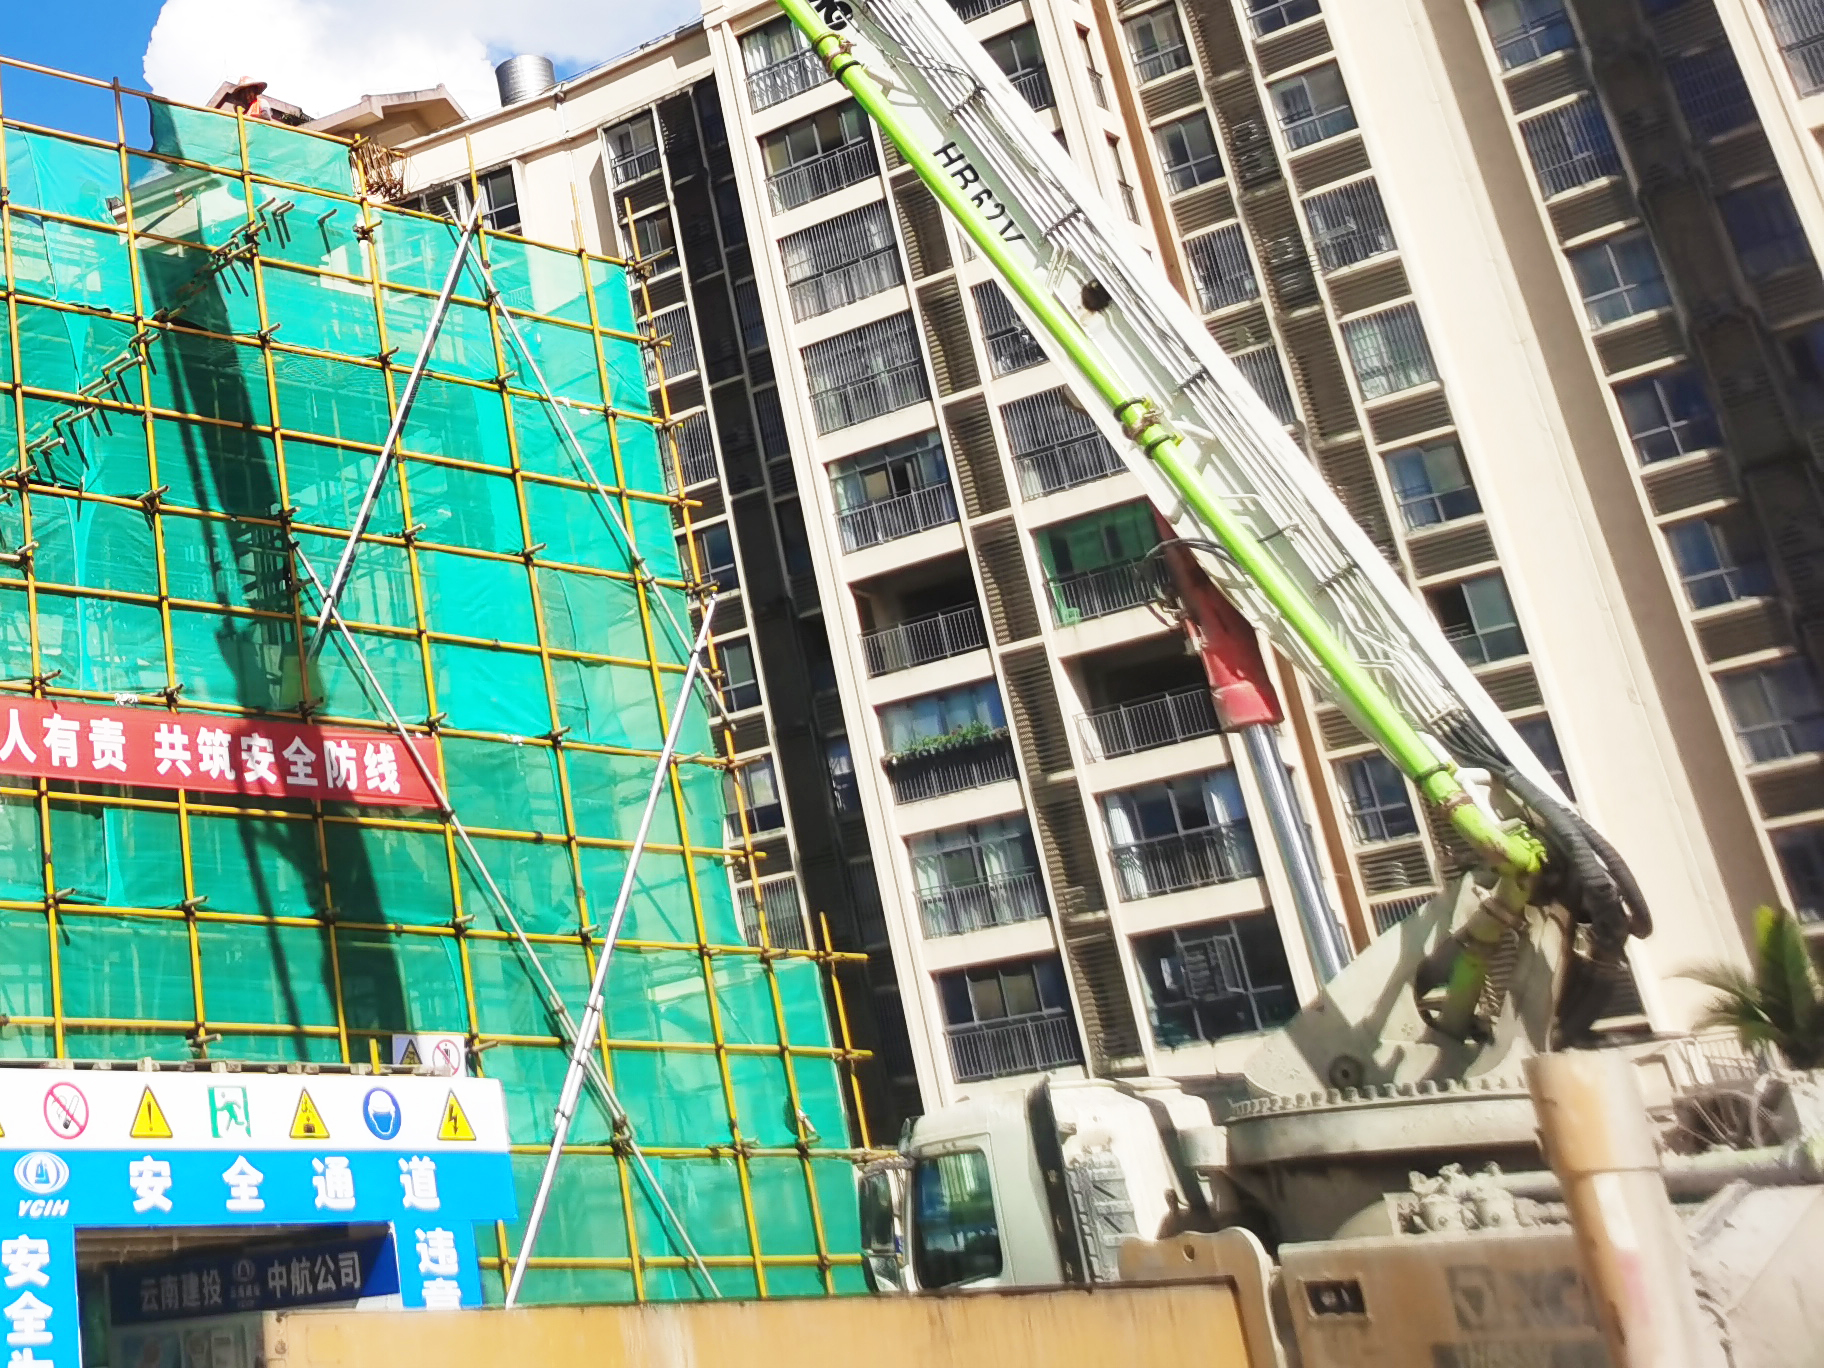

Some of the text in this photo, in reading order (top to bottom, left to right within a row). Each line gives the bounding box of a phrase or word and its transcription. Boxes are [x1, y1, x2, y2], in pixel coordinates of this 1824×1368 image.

[154, 723, 401, 794] 共筑安全防线
[17, 1199, 70, 1219] YCIH
[129, 1155, 441, 1213] 安全通道
[140, 1250, 362, 1312] 云南建投 中航公司
